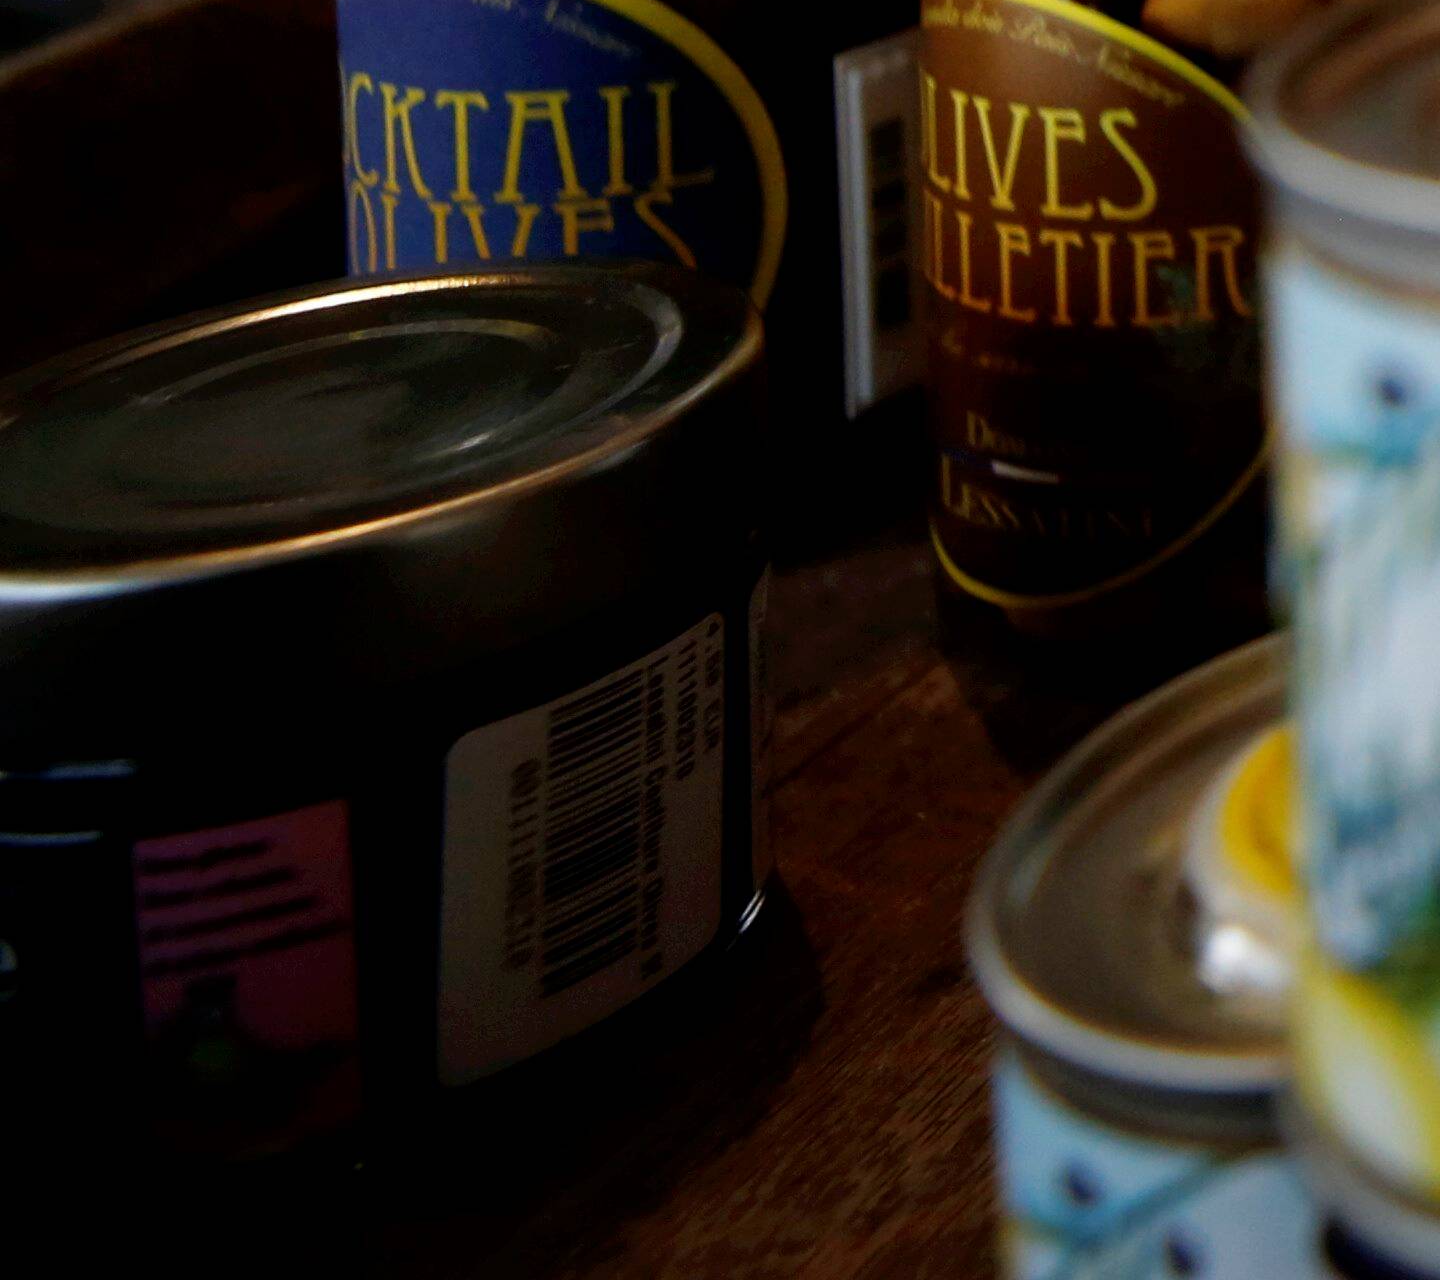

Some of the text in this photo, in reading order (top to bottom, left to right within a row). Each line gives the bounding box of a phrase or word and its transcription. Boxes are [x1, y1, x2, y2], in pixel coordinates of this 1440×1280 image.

[345, 73, 716, 203] CKTAIL
[921, 74, 1157, 222] LIVES
[923, 186, 1253, 328] LLETIER
